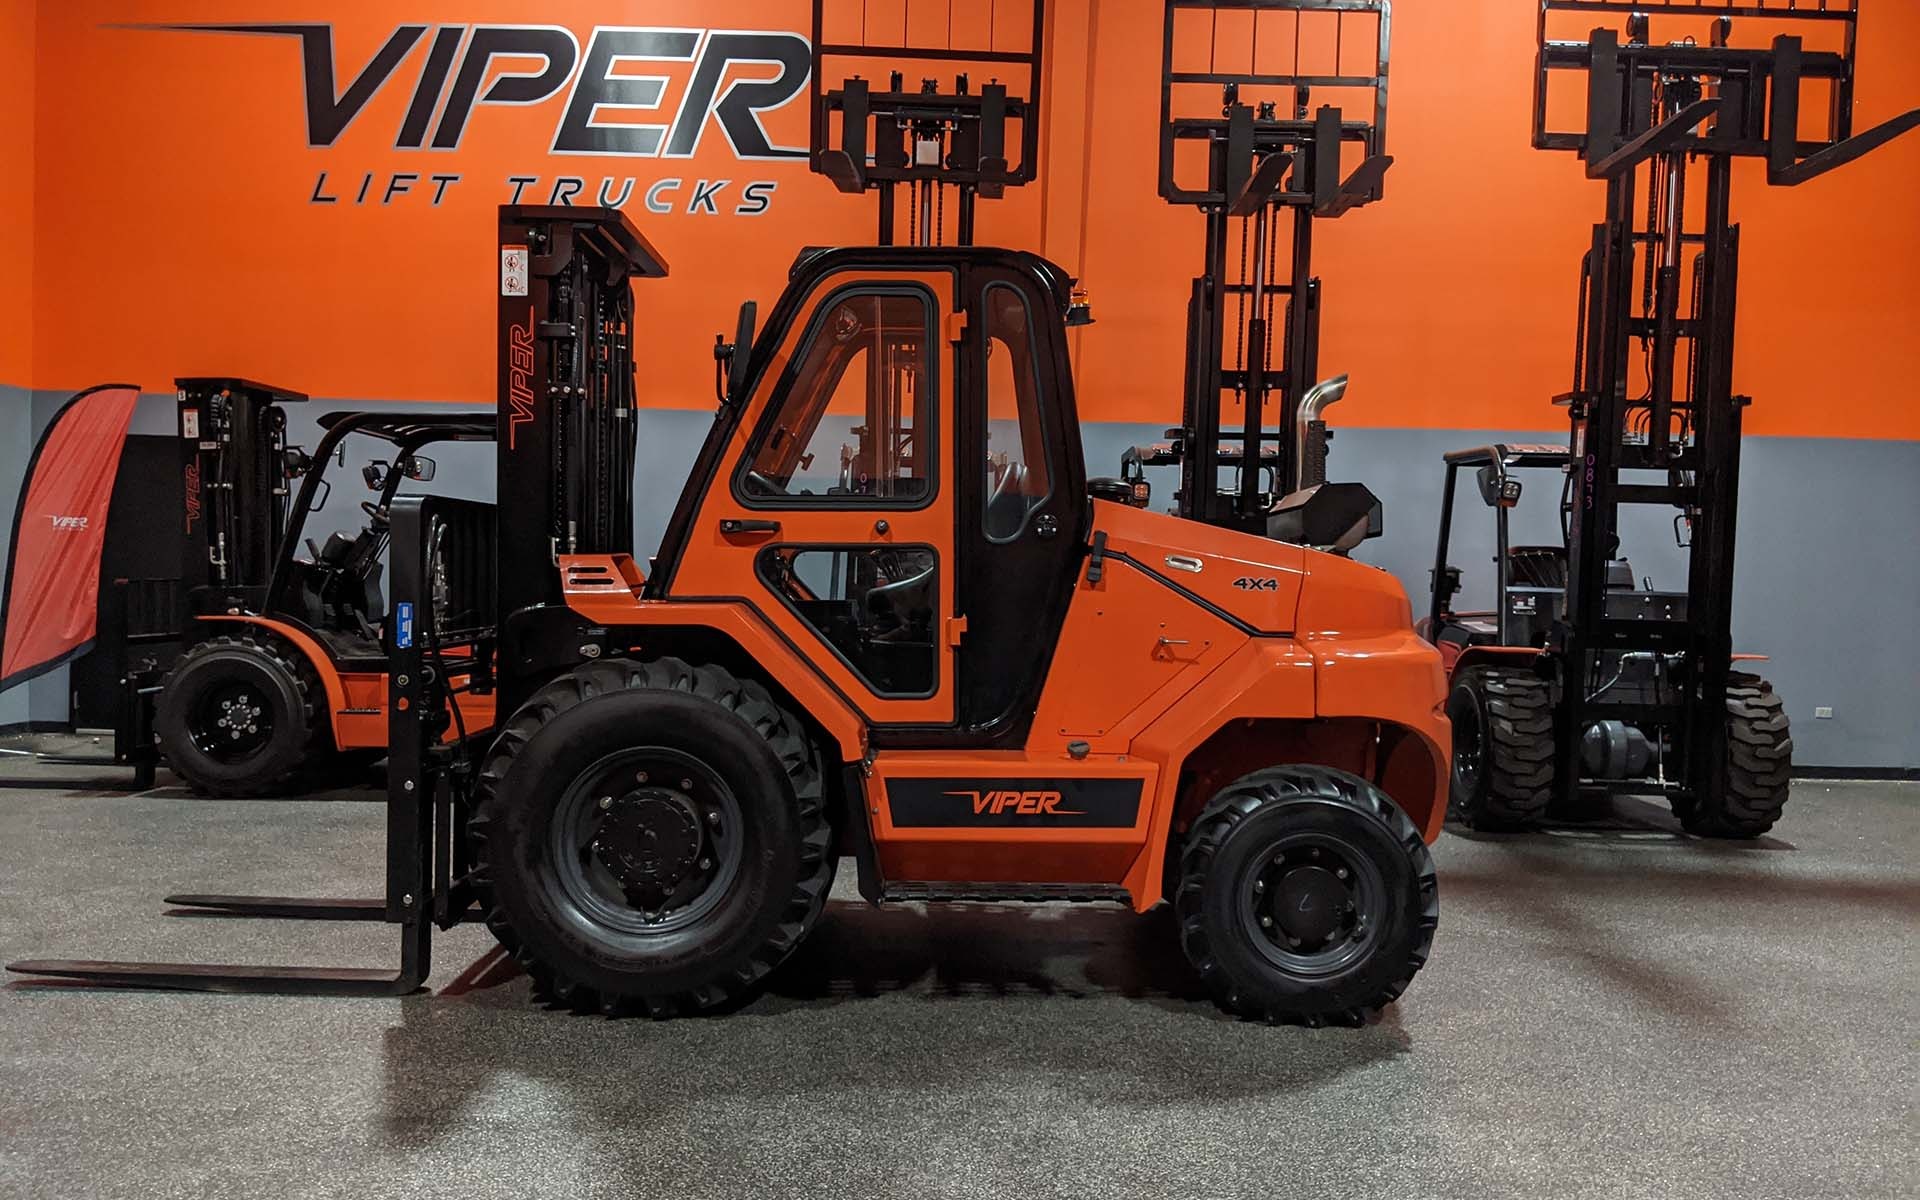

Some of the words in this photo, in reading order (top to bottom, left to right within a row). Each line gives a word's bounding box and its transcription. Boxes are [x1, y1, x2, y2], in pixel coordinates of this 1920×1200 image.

[100, 23, 812, 160] VIPER
[309, 172, 461, 207] LIFT
[505, 176, 777, 216] TRUCKS
[510, 305, 534, 450] VIPER
[43, 514, 88, 528] VIPER
[1232, 577, 1279, 592] 4X4
[941, 790, 1088, 814] VIPER
